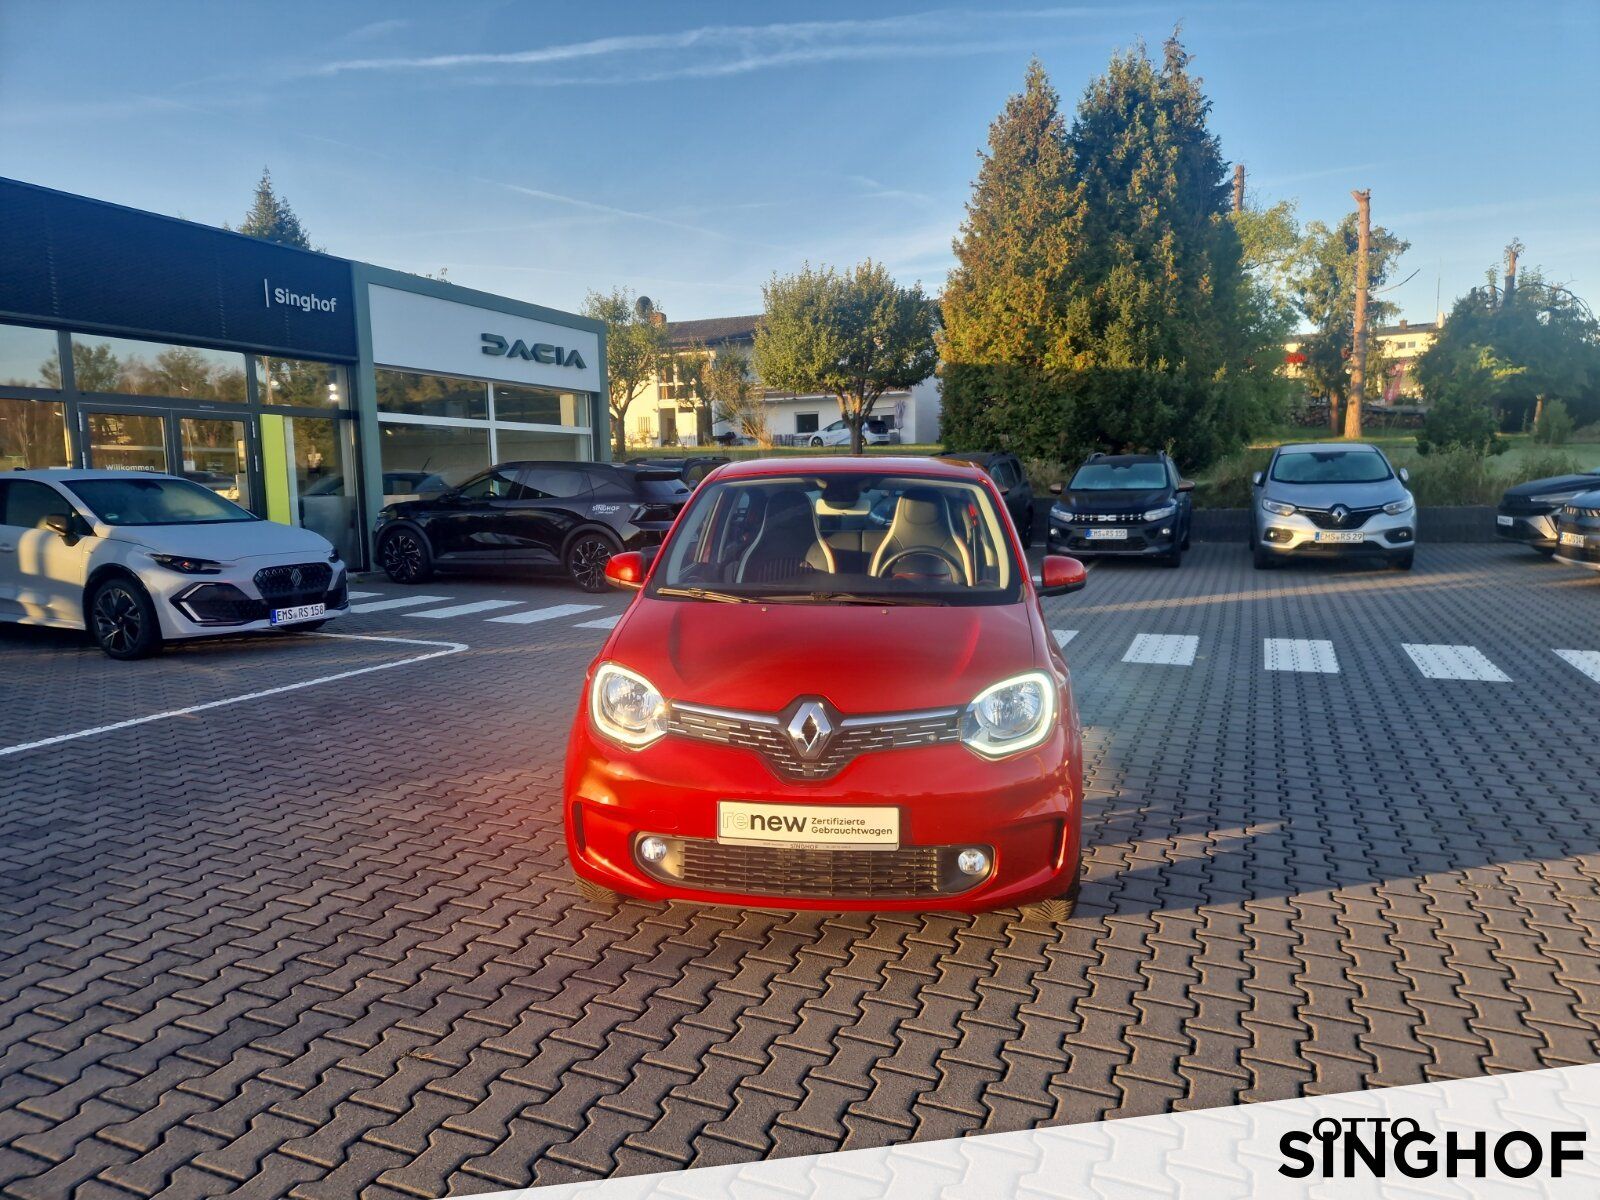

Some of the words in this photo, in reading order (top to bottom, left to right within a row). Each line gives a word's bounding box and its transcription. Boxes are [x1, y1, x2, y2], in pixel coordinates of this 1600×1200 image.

[274, 287, 337, 312] Singhof
[481, 333, 587, 369] DACIA
[1321, 533, 1336, 541] EMS
[1340, 533, 1352, 541] RS
[276, 609, 293, 621] EMS
[298, 607, 309, 618] RS
[310, 604, 324, 616] 158
[811, 817, 866, 826] Zertifizierte
[811, 826, 893, 837] Gebrauchtwagen
